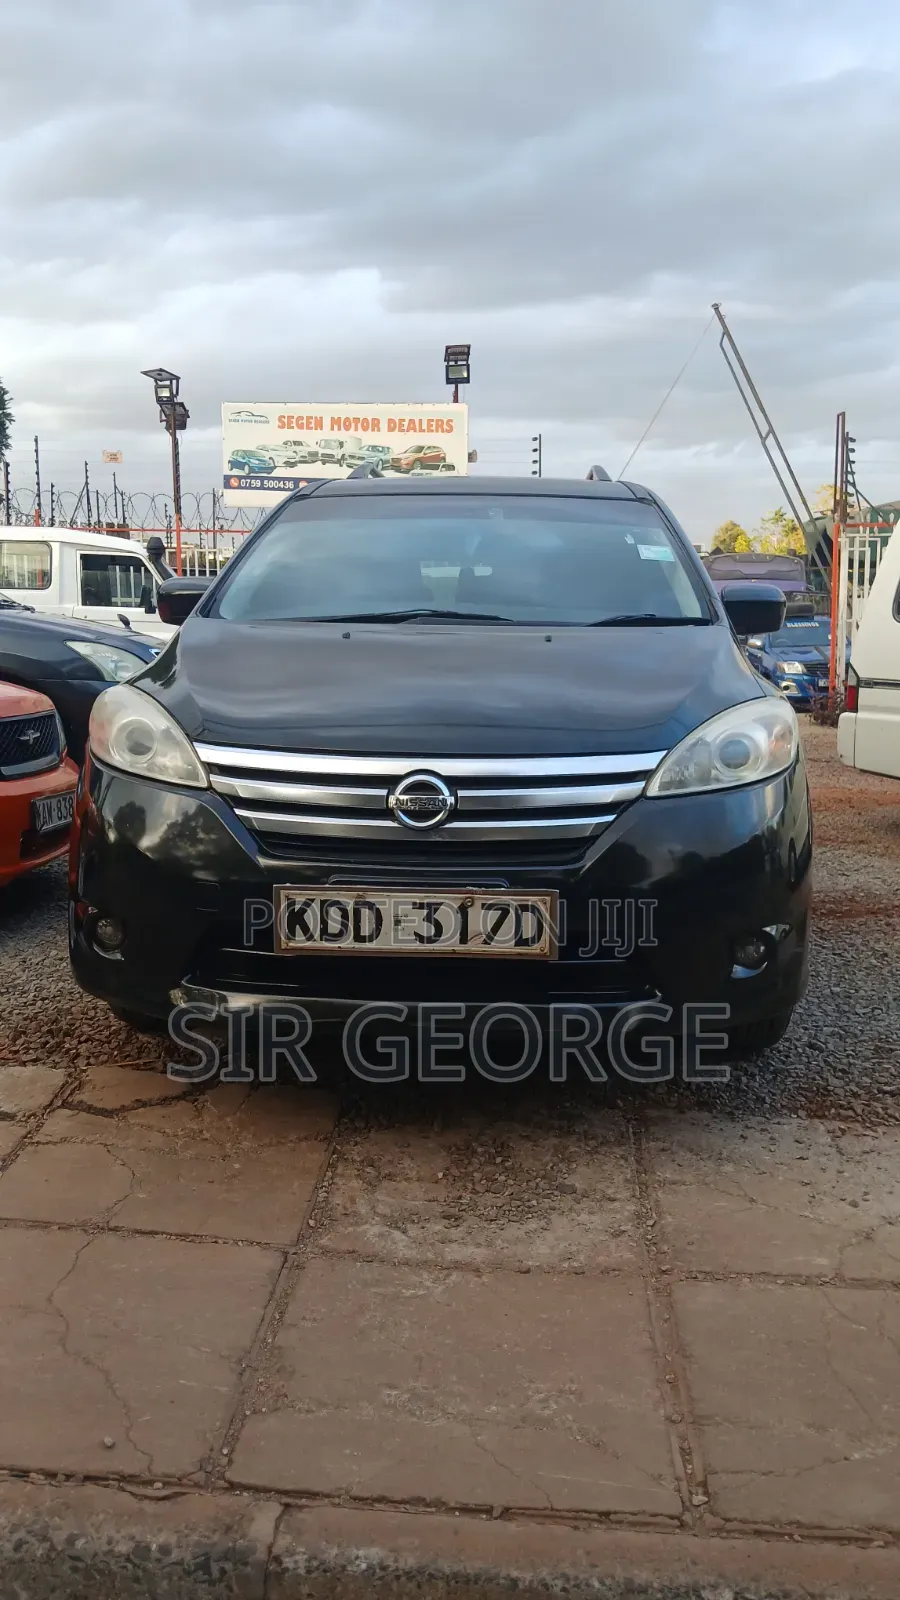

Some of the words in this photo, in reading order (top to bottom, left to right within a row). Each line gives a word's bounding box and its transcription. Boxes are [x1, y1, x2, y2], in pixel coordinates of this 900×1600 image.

[277, 415, 323, 431] SEGEN
[330, 416, 381, 432] MOTOR
[387, 418, 454, 433] DEALERS
[240, 479, 261, 488] 0759
[263, 480, 295, 489] 500436
[395, 797, 447, 807] NISSAN
[286, 897, 384, 944] KDD
[411, 901, 544, 947] 317D
